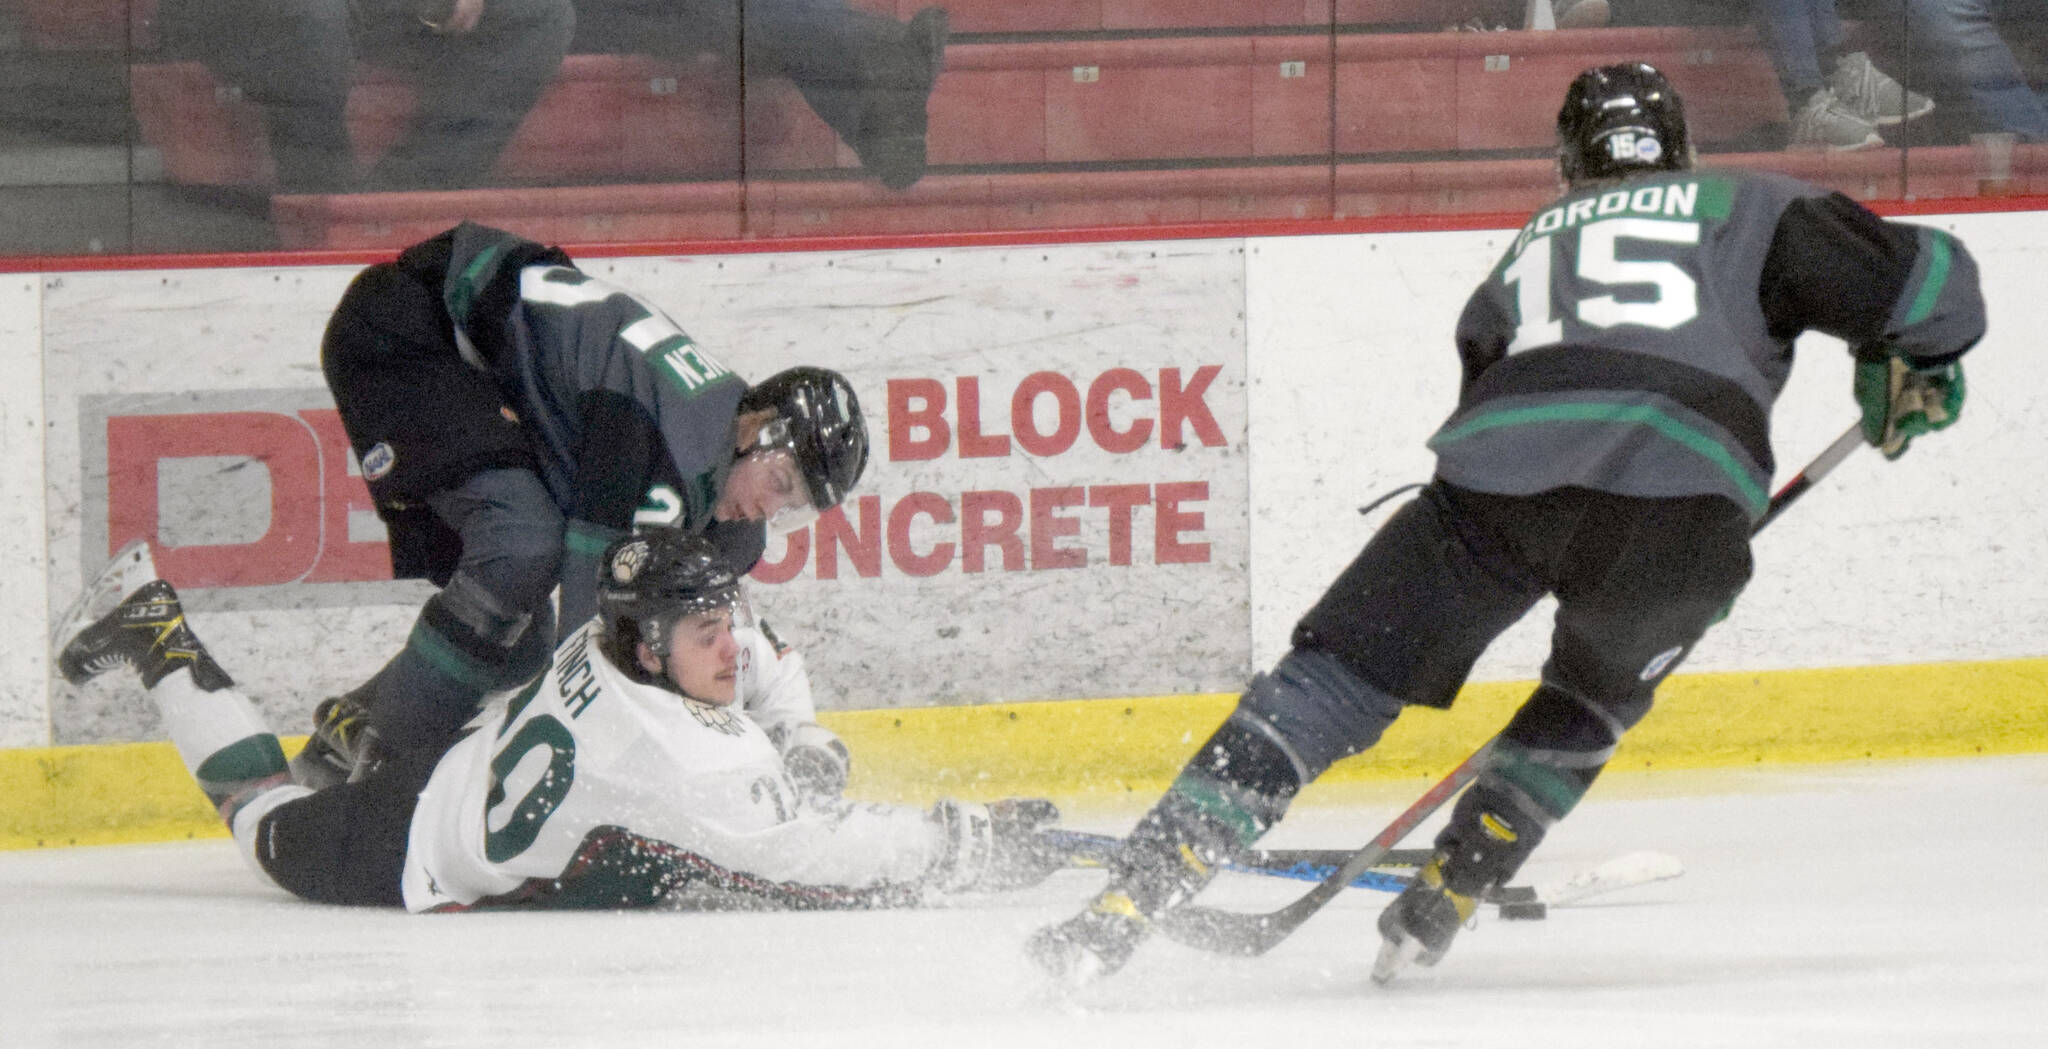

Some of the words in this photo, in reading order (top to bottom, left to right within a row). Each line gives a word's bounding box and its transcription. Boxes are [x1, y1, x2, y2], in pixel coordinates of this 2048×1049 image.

[1610, 133, 1636, 160] 15
[1504, 218, 1700, 356] 15
[887, 365, 1228, 462] BLOCK
[551, 629, 602, 720] FINCH
